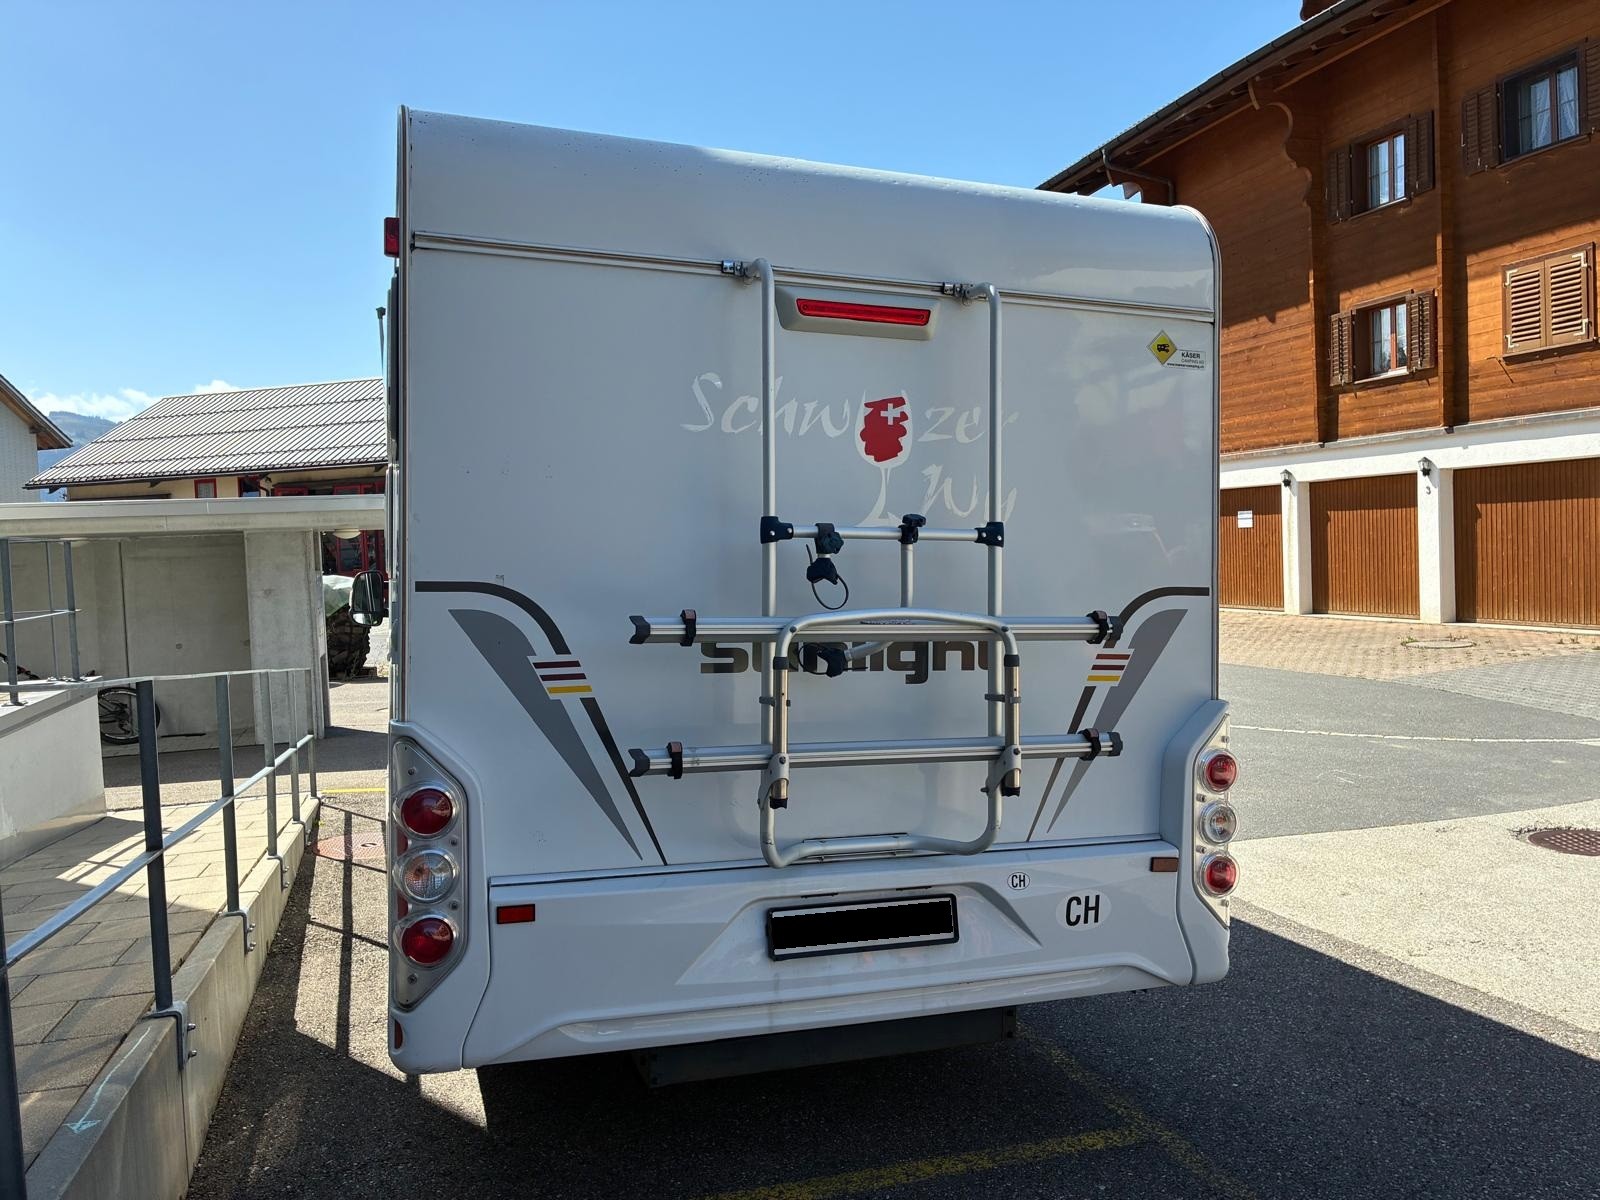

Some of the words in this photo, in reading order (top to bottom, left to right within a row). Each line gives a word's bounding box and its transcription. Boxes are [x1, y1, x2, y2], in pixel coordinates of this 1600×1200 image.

[1425, 486, 1432, 495] 3
[1011, 874, 1026, 888] CH
[1065, 894, 1101, 927] CH
